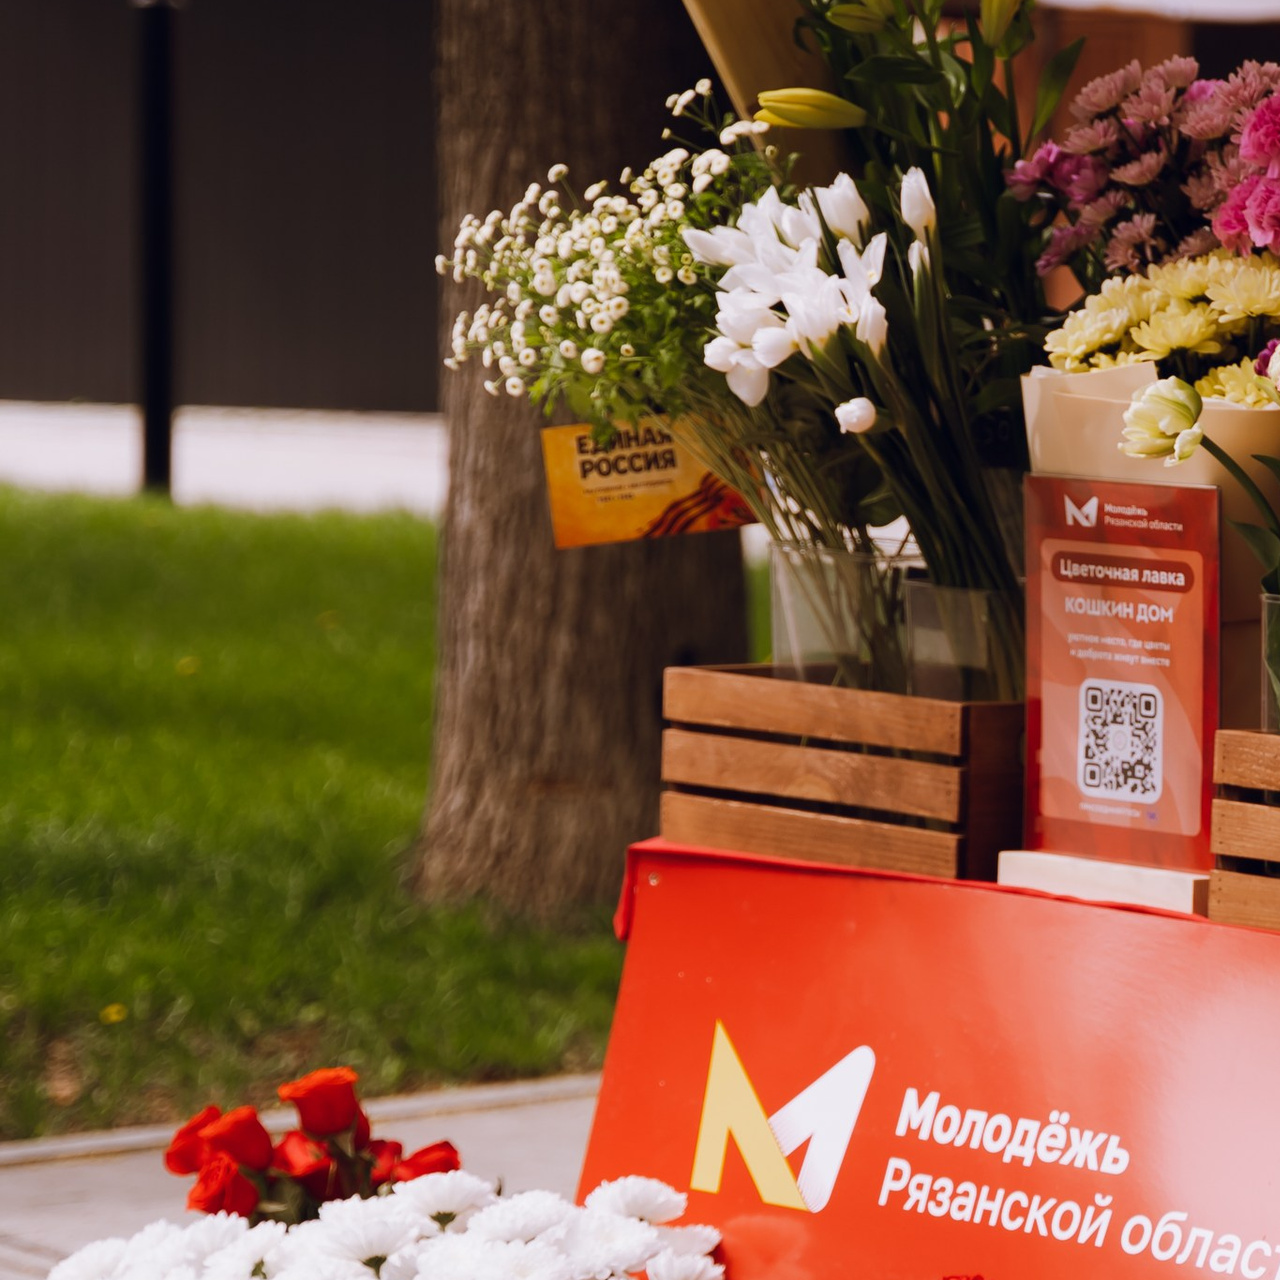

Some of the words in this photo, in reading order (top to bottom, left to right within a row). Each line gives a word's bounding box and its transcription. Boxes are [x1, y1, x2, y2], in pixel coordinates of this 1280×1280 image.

[580, 448, 677, 479] РОССИЯ
[1060, 559, 1139, 582] Цветочная
[1141, 569, 1185, 586] лавка
[1065, 597, 1134, 619] КОШКИН
[1136, 603, 1174, 624] ДОМ
[895, 1087, 1131, 1176] Молодёжь
[878, 1157, 1114, 1248] Рязанской
